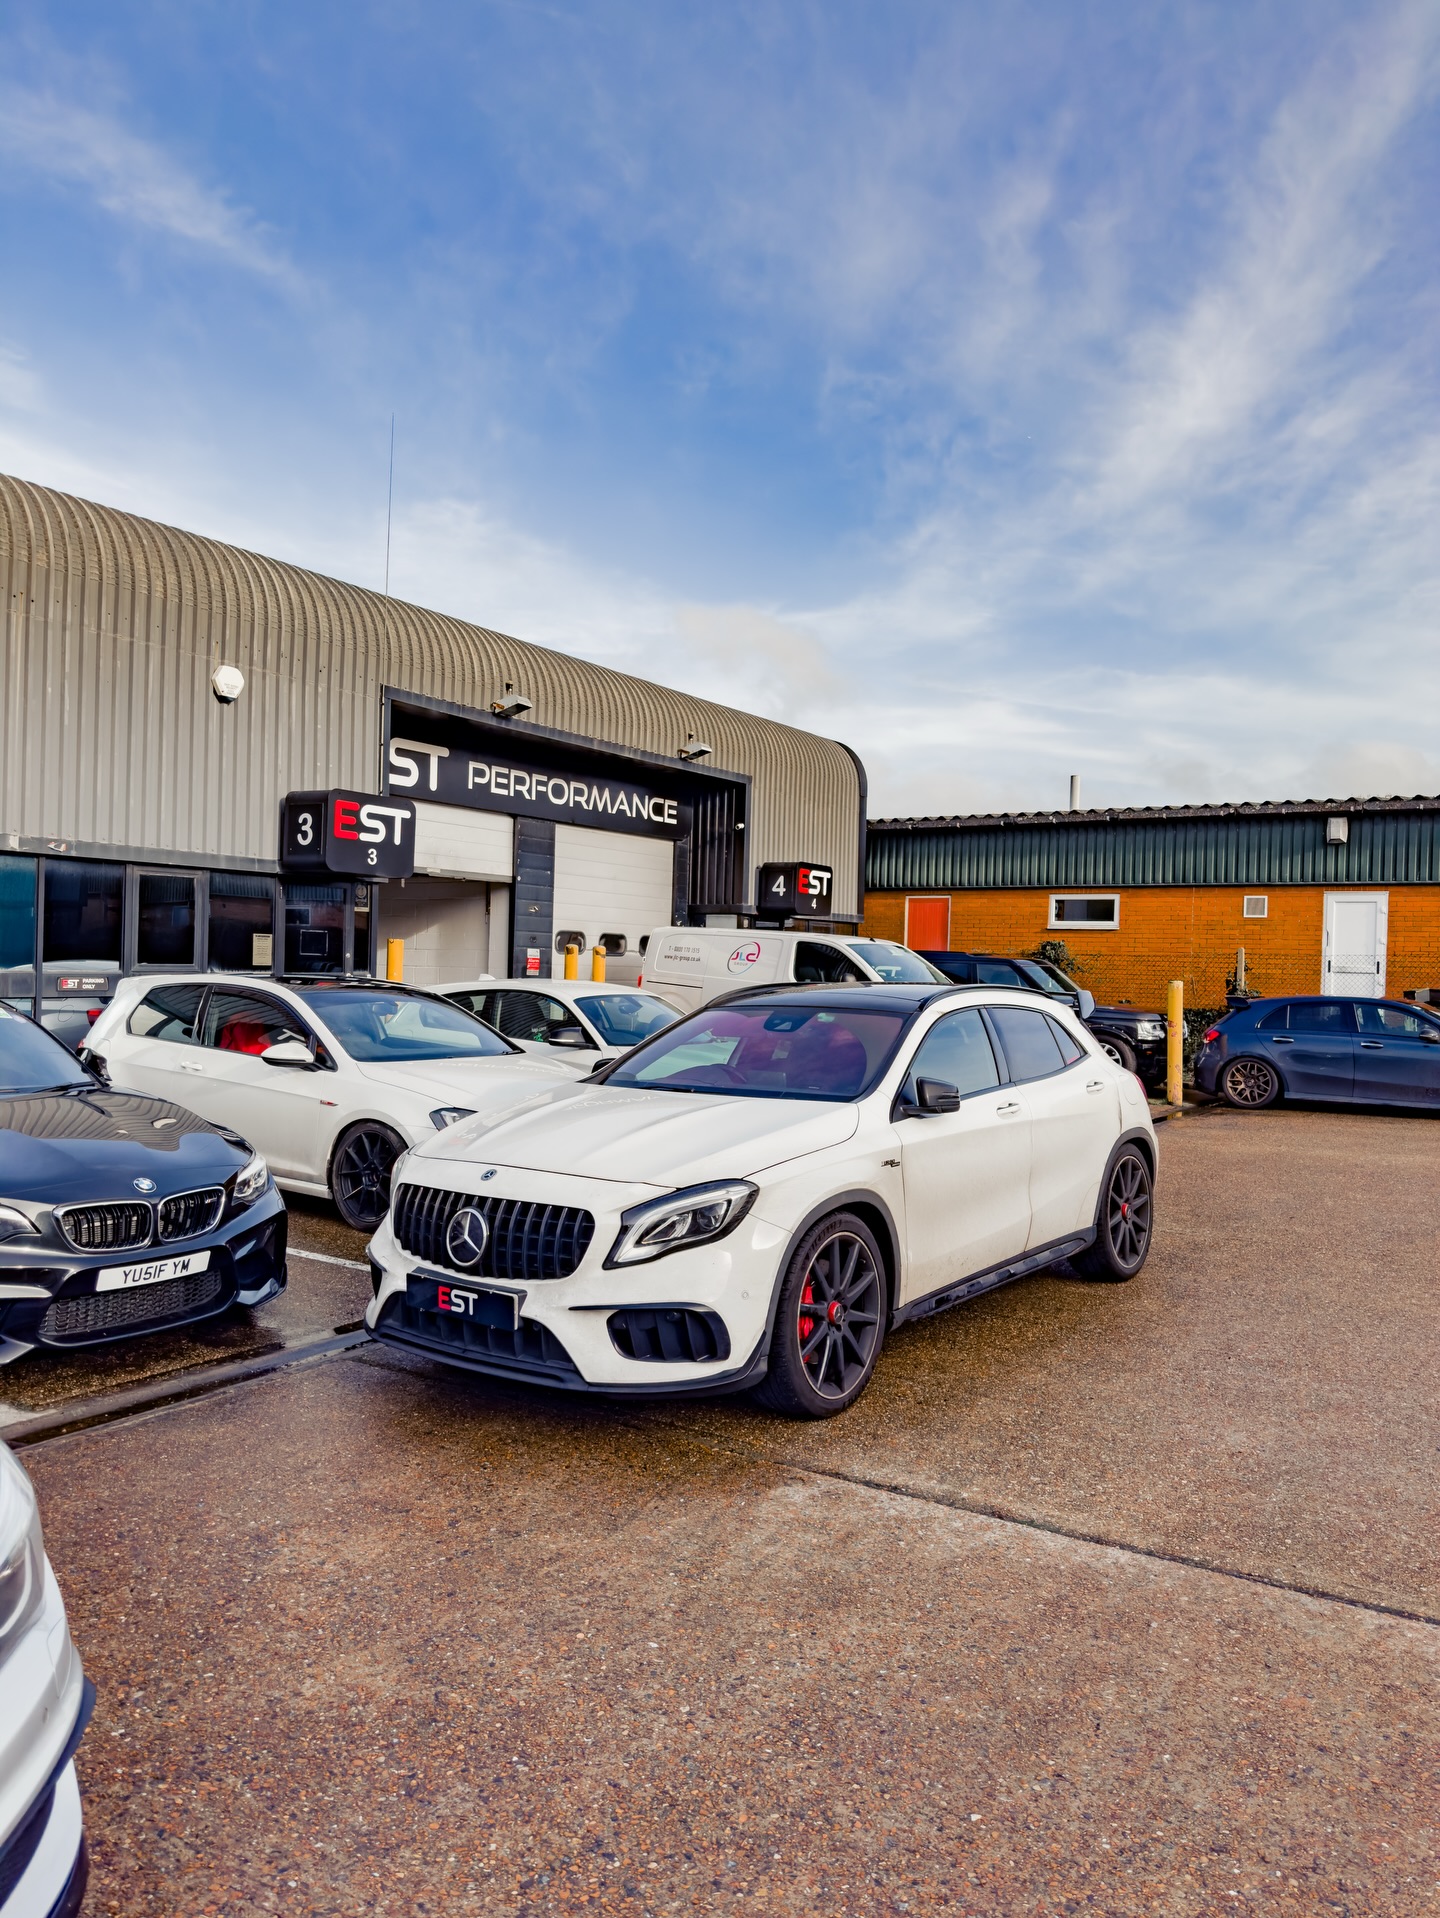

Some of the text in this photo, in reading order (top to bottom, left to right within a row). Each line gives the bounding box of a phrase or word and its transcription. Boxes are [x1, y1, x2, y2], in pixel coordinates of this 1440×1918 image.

[468, 760, 678, 825] PERFORMANCE
[296, 812, 313, 846] 3
[333, 799, 411, 845] EST
[367, 848, 378, 865] 3
[771, 875, 786, 897] 4
[798, 868, 831, 896] EST
[811, 898, 817, 909] 4
[62, 979, 79, 988] EST
[173, 1258, 191, 1275] YM
[438, 1285, 478, 1315] EST
